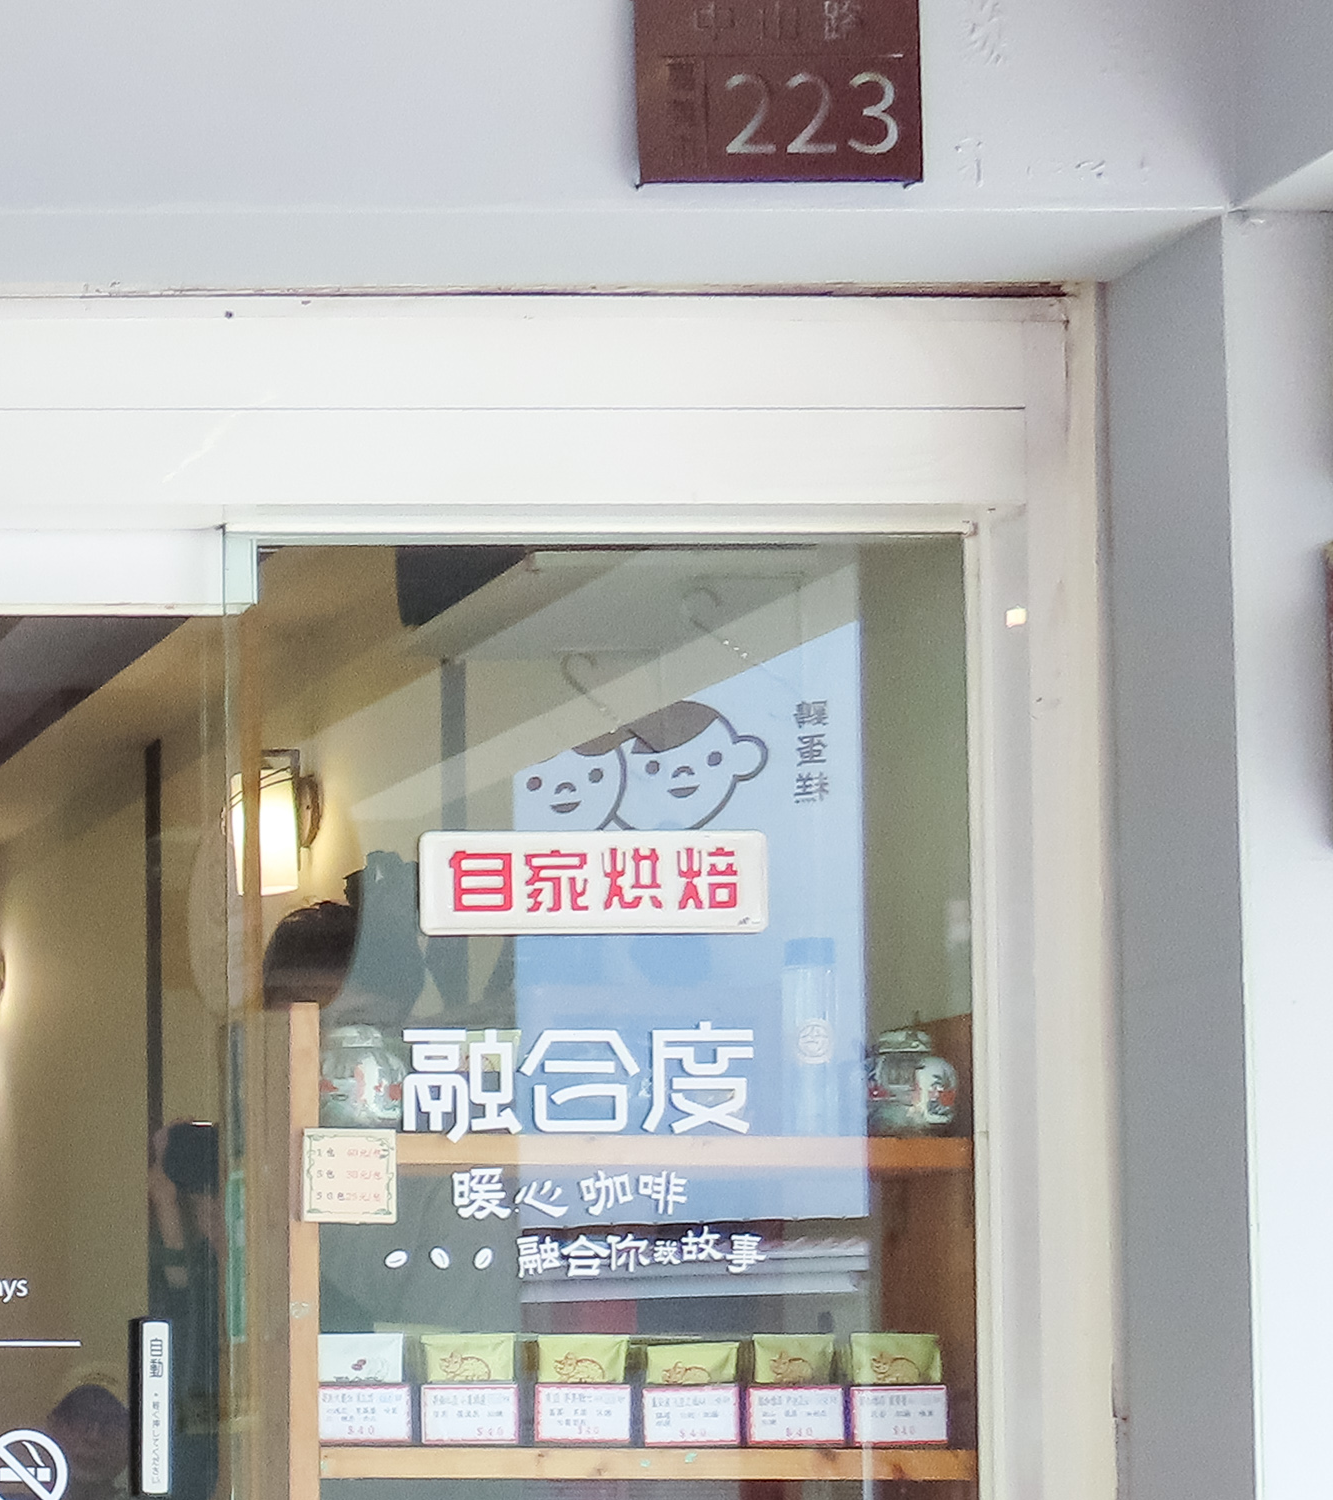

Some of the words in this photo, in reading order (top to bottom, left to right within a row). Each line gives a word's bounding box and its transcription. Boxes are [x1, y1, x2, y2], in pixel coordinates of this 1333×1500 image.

[725, 71, 900, 155] 223
[448, 847, 739, 913] 自家烘焙
[402, 1021, 754, 1143] 融合度
[452, 1168, 688, 1220] 暖心咖啡
[516, 1226, 767, 1278] 融合你我故事
